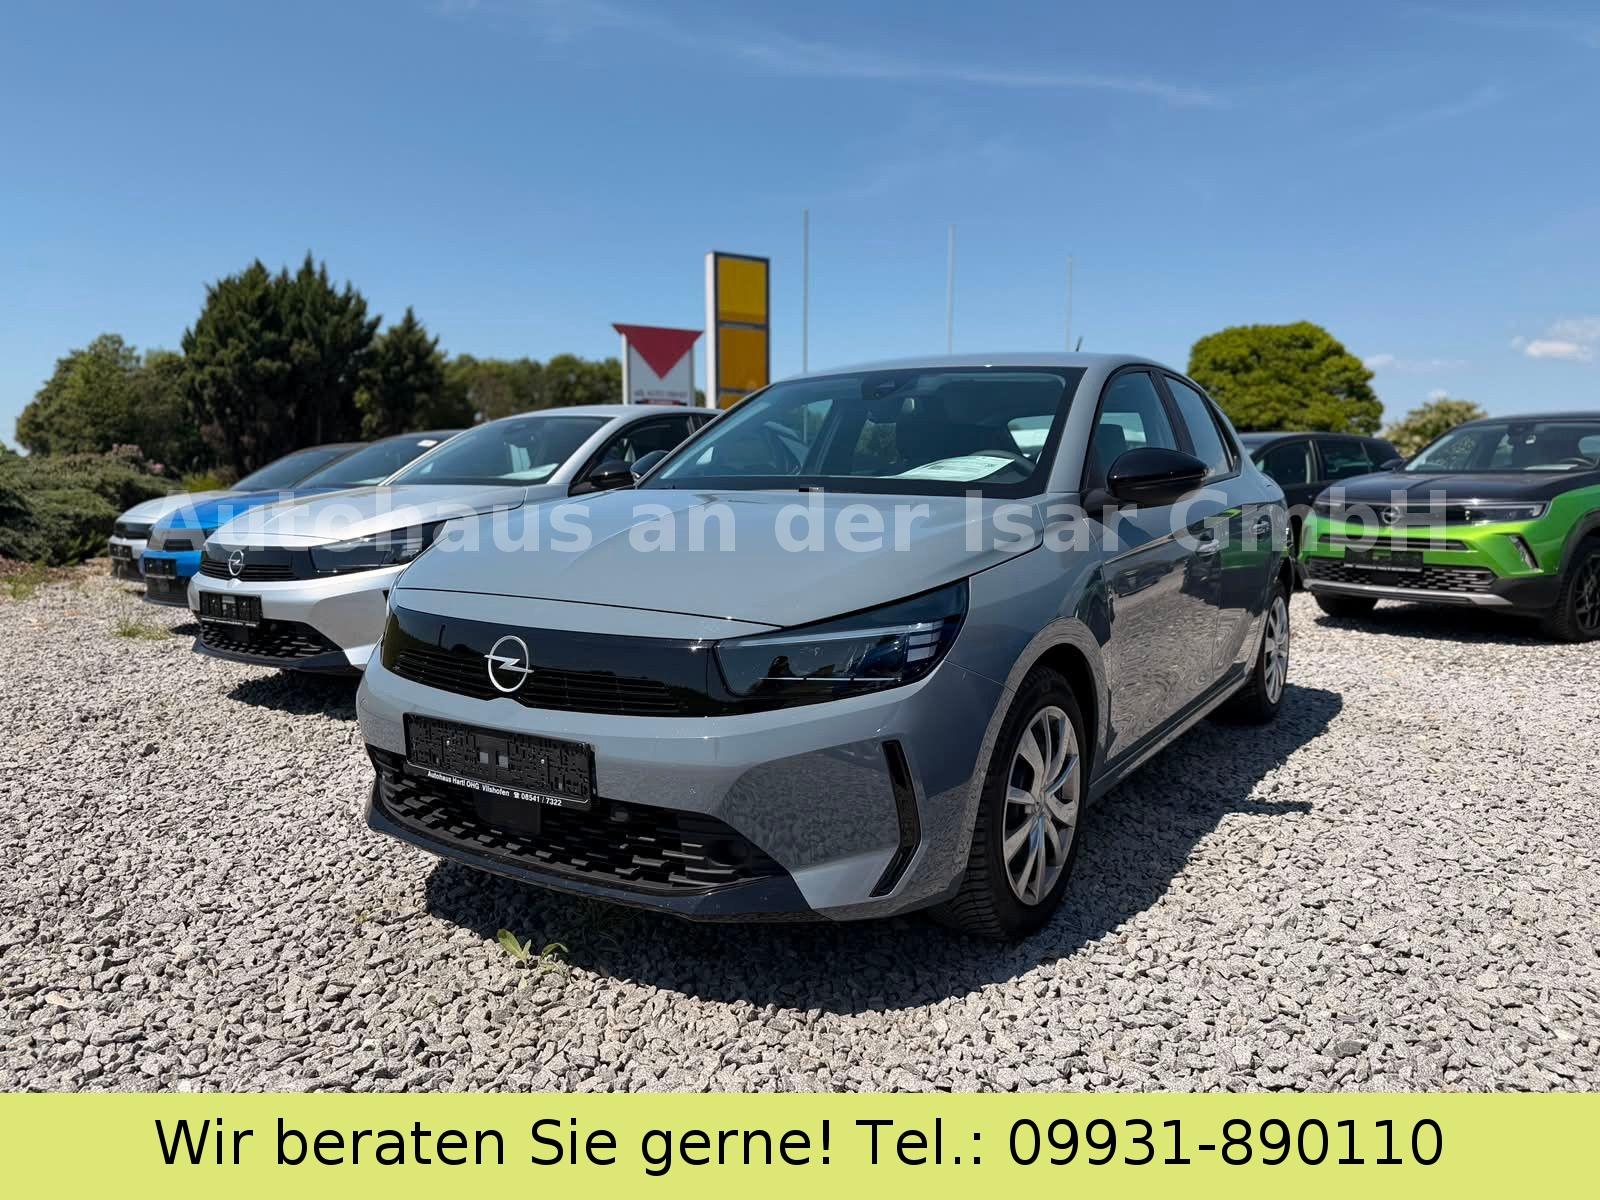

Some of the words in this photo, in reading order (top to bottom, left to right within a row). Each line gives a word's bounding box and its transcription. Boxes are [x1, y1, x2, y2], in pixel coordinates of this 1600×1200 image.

[428, 770, 452, 783] Autohaus
[452, 776, 466, 787] Hartl
[466, 780, 480, 790] OHG
[482, 784, 510, 797] Vilshofen
[521, 792, 540, 803] 08541
[546, 797, 562, 807] 7322
